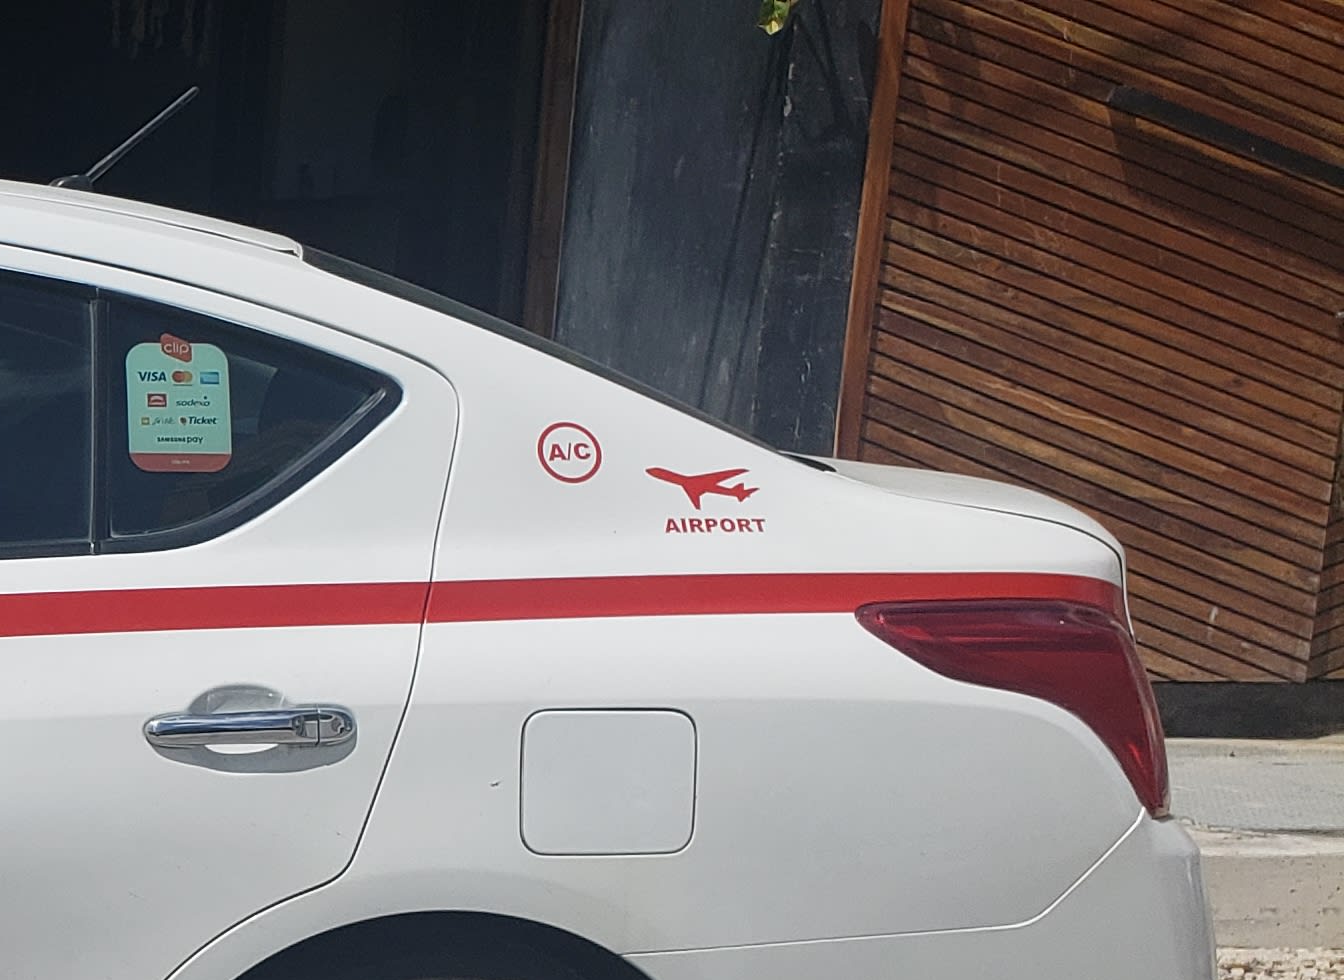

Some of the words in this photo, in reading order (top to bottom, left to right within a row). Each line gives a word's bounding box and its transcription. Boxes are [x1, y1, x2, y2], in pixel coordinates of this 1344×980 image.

[163, 343, 189, 355] clip
[138, 371, 167, 382] VISA
[189, 416, 218, 425] Ticket
[186, 436, 204, 445] pay
[548, 442, 591, 461] A/C
[664, 517, 766, 534] AIRPORT
